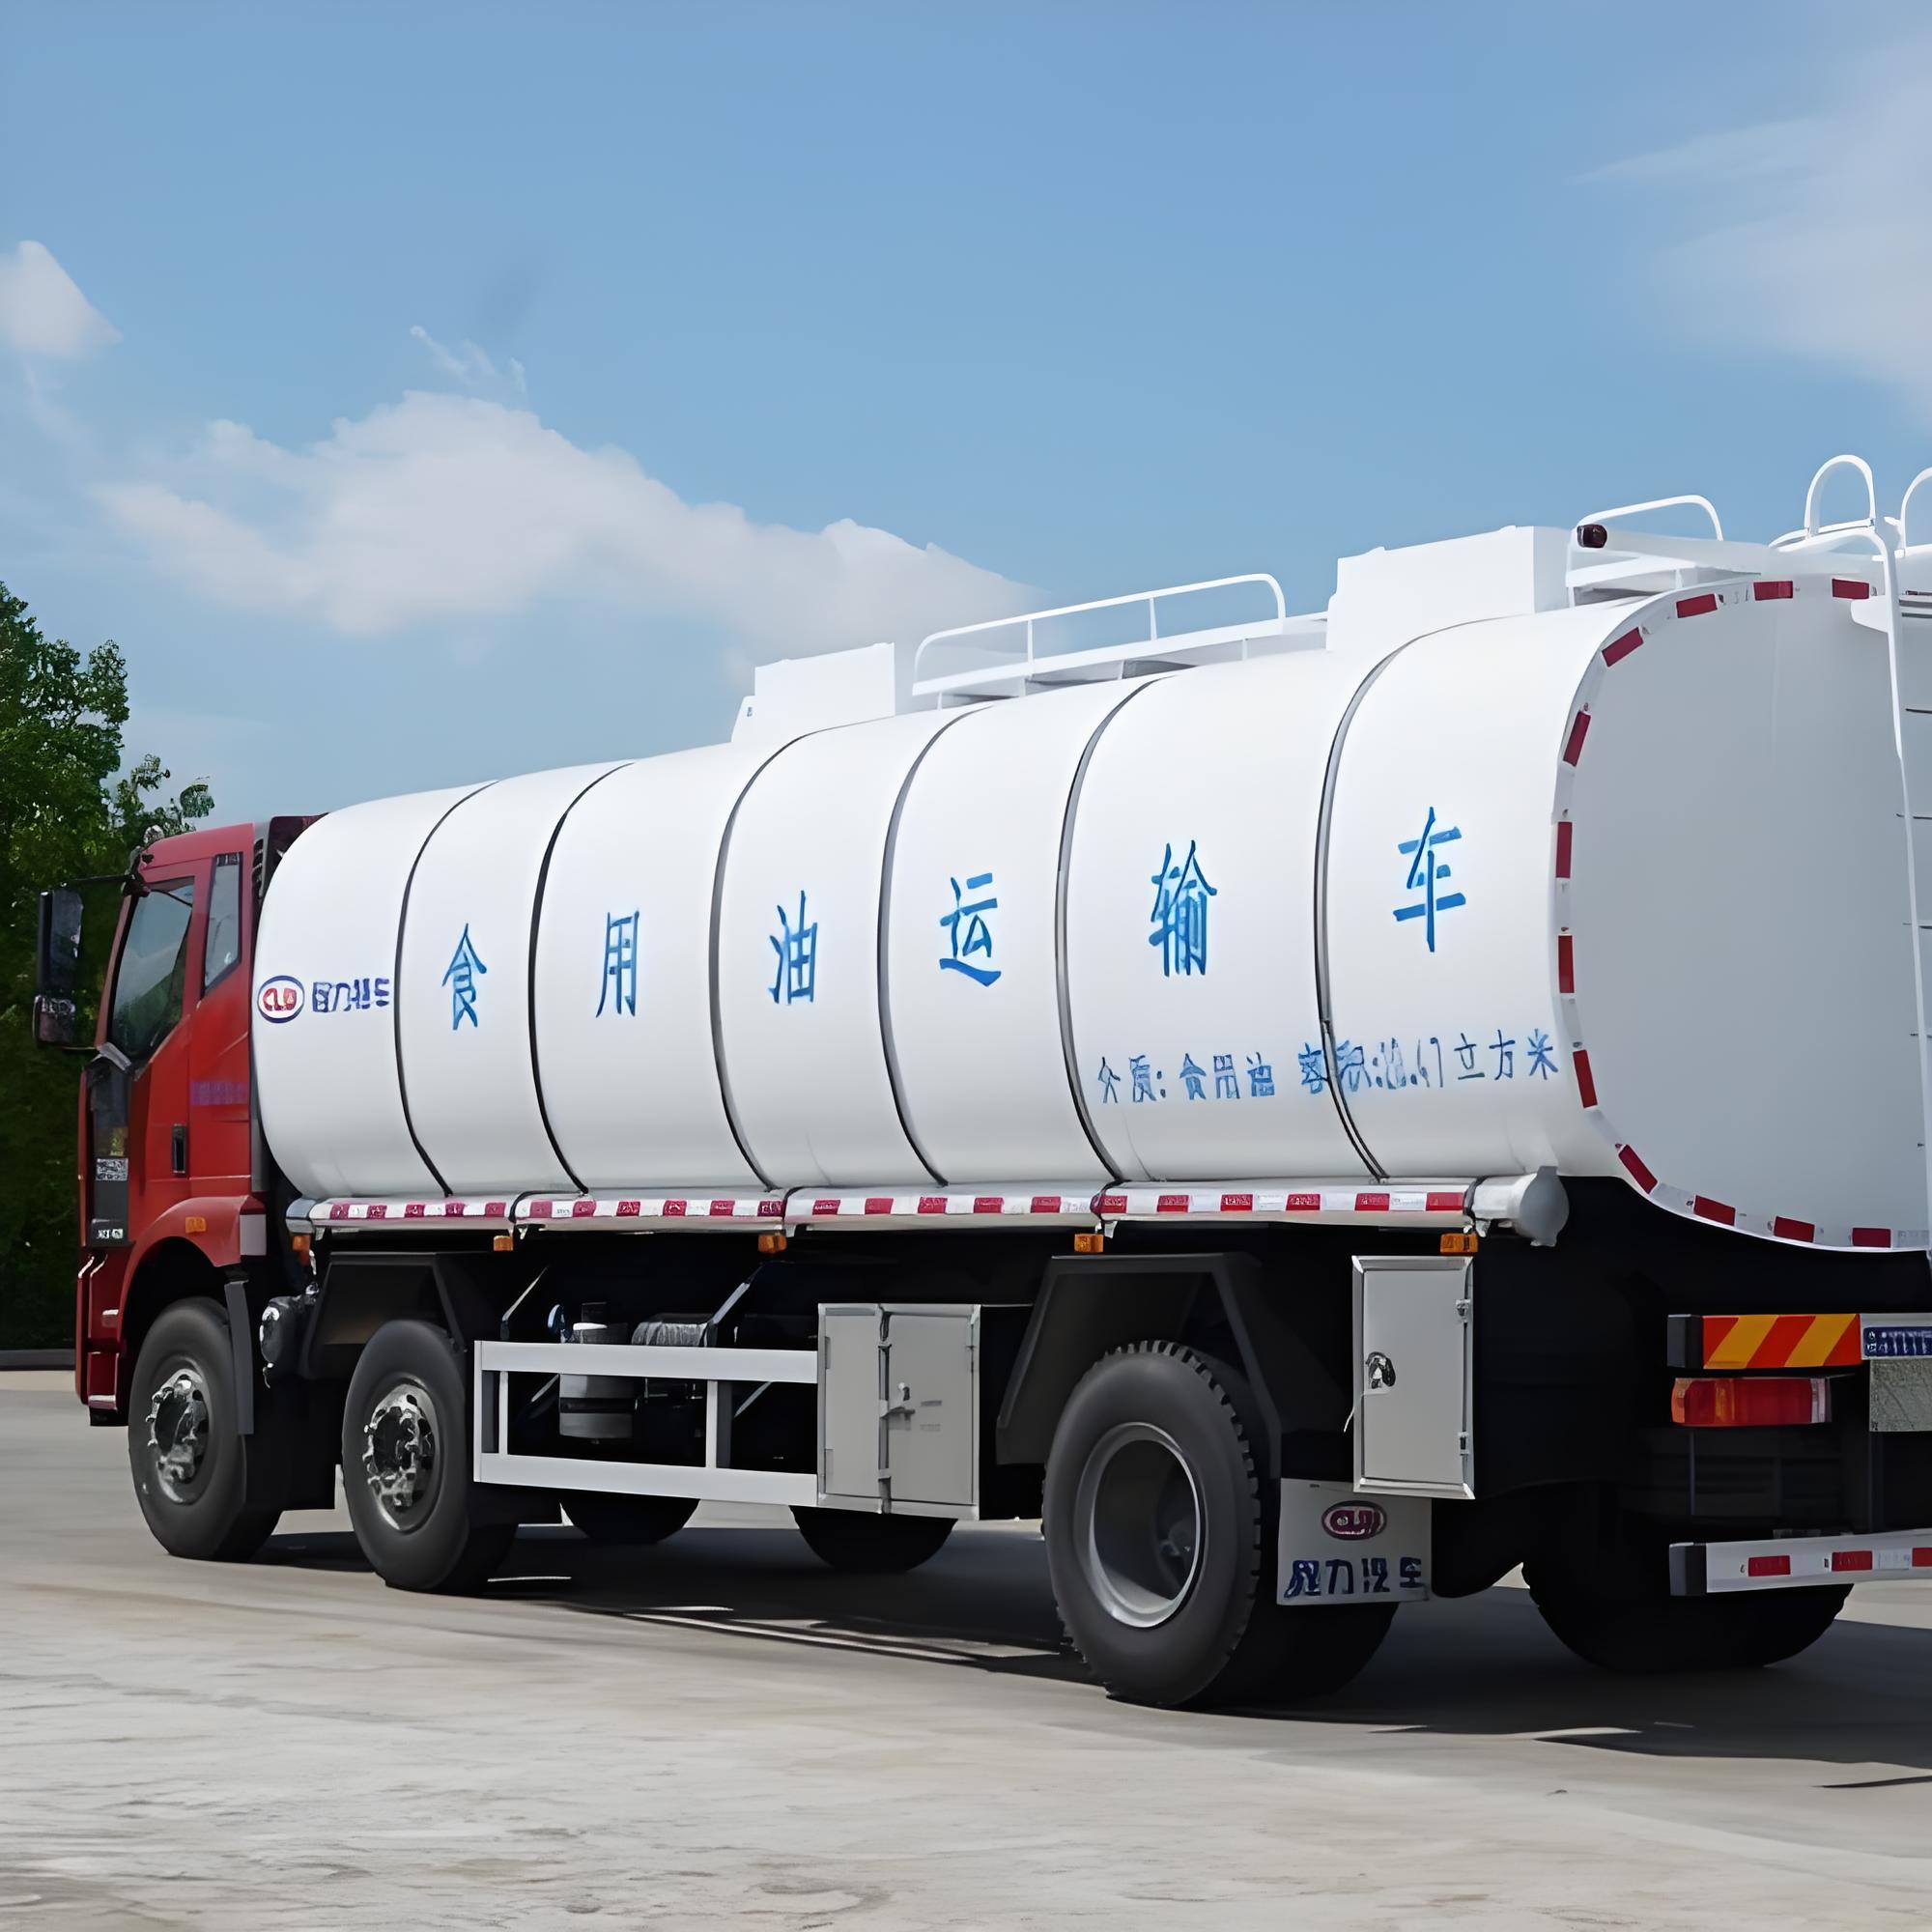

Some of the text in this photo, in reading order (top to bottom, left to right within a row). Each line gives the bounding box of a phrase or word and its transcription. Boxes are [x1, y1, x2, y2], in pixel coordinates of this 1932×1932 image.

[441, 806, 1467, 1032] 食用油运输车
